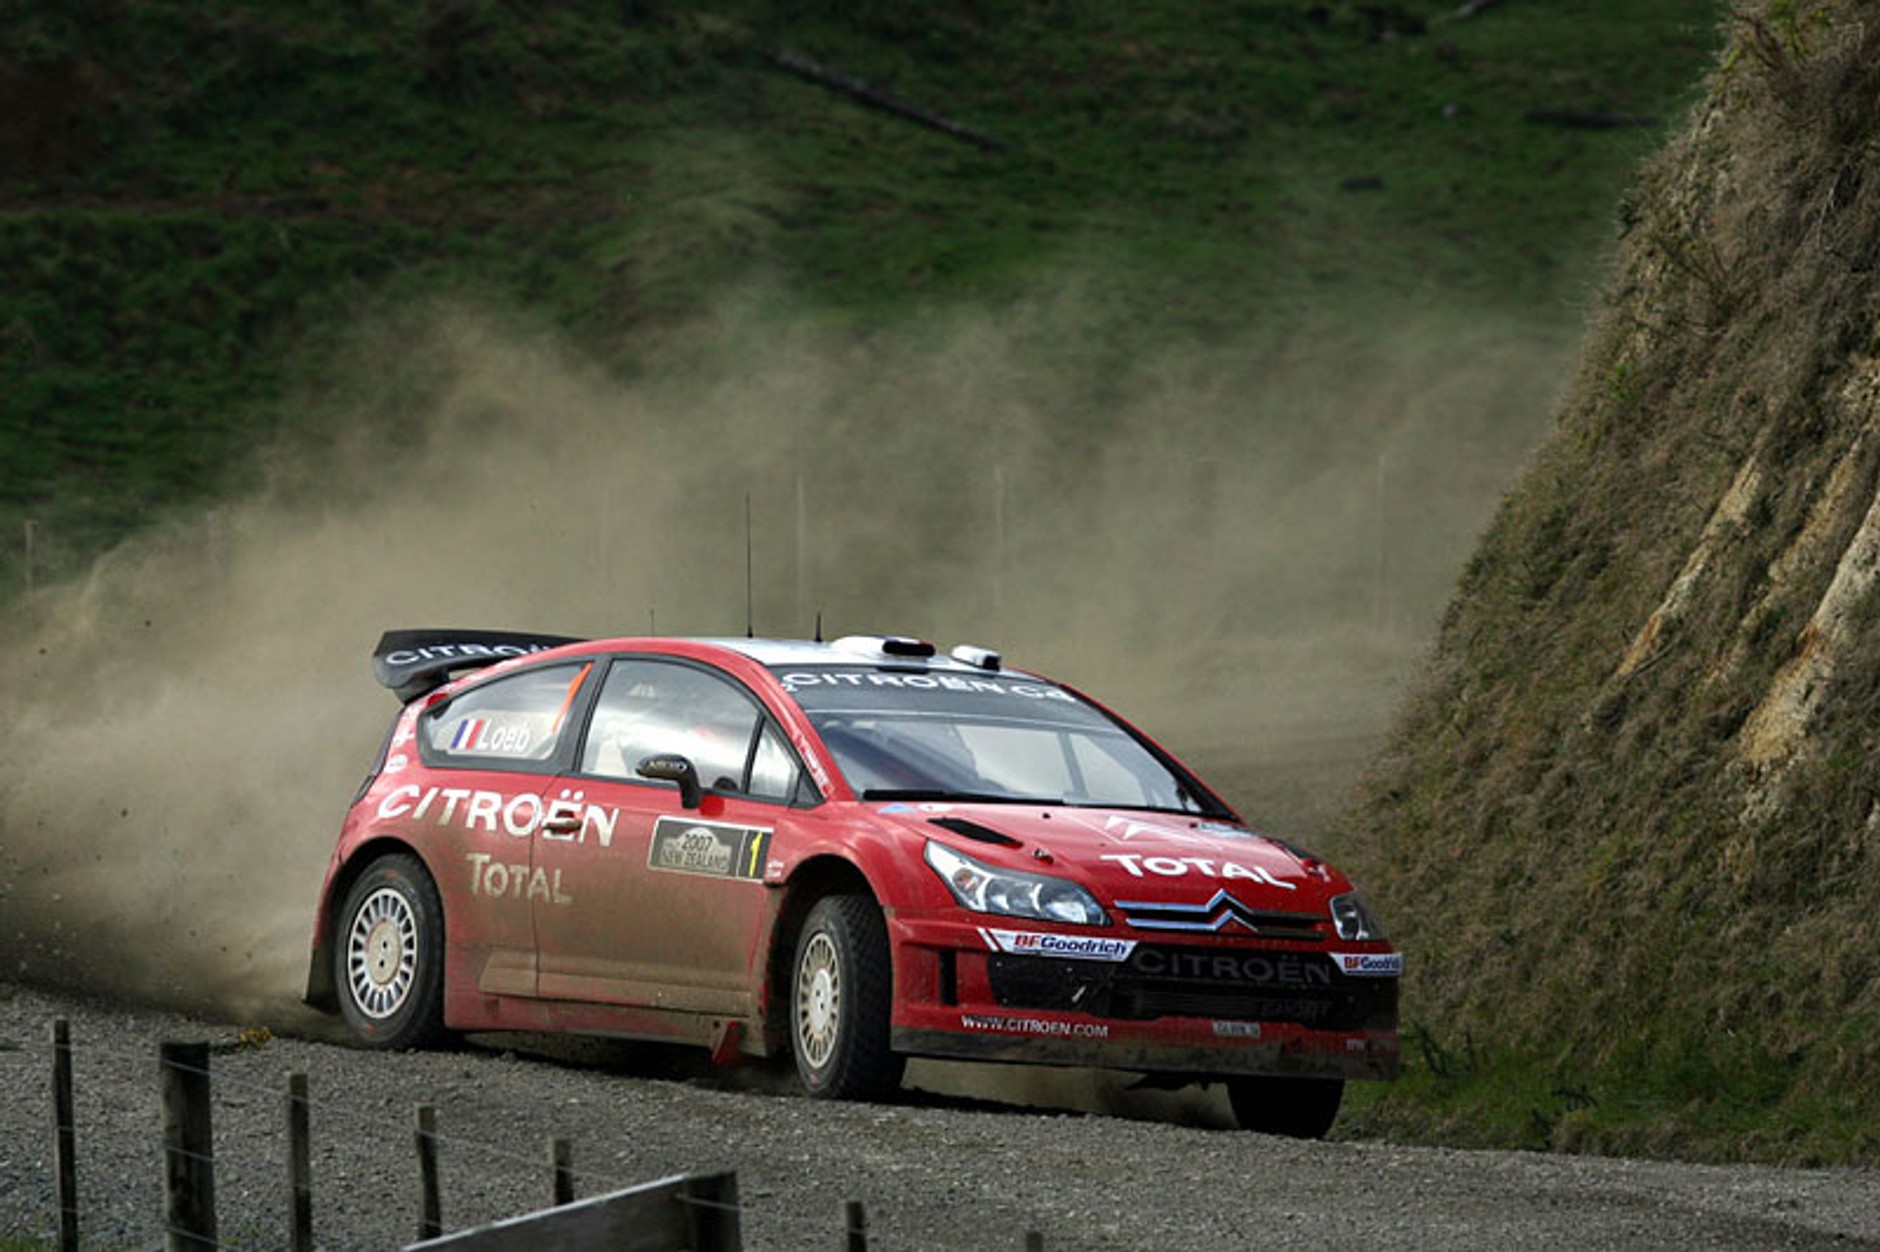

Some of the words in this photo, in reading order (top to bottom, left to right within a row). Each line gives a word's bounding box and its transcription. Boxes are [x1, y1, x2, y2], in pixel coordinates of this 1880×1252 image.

[385, 643, 550, 664] CITRO
[480, 718, 531, 750] Loeb
[376, 784, 620, 847] CITROËN
[681, 833, 713, 851] 2007
[748, 830, 764, 878] 1
[1099, 854, 1297, 890] TOTAL
[1013, 934, 1128, 956] BFGoodrich
[1130, 950, 1333, 984] CITROËN
